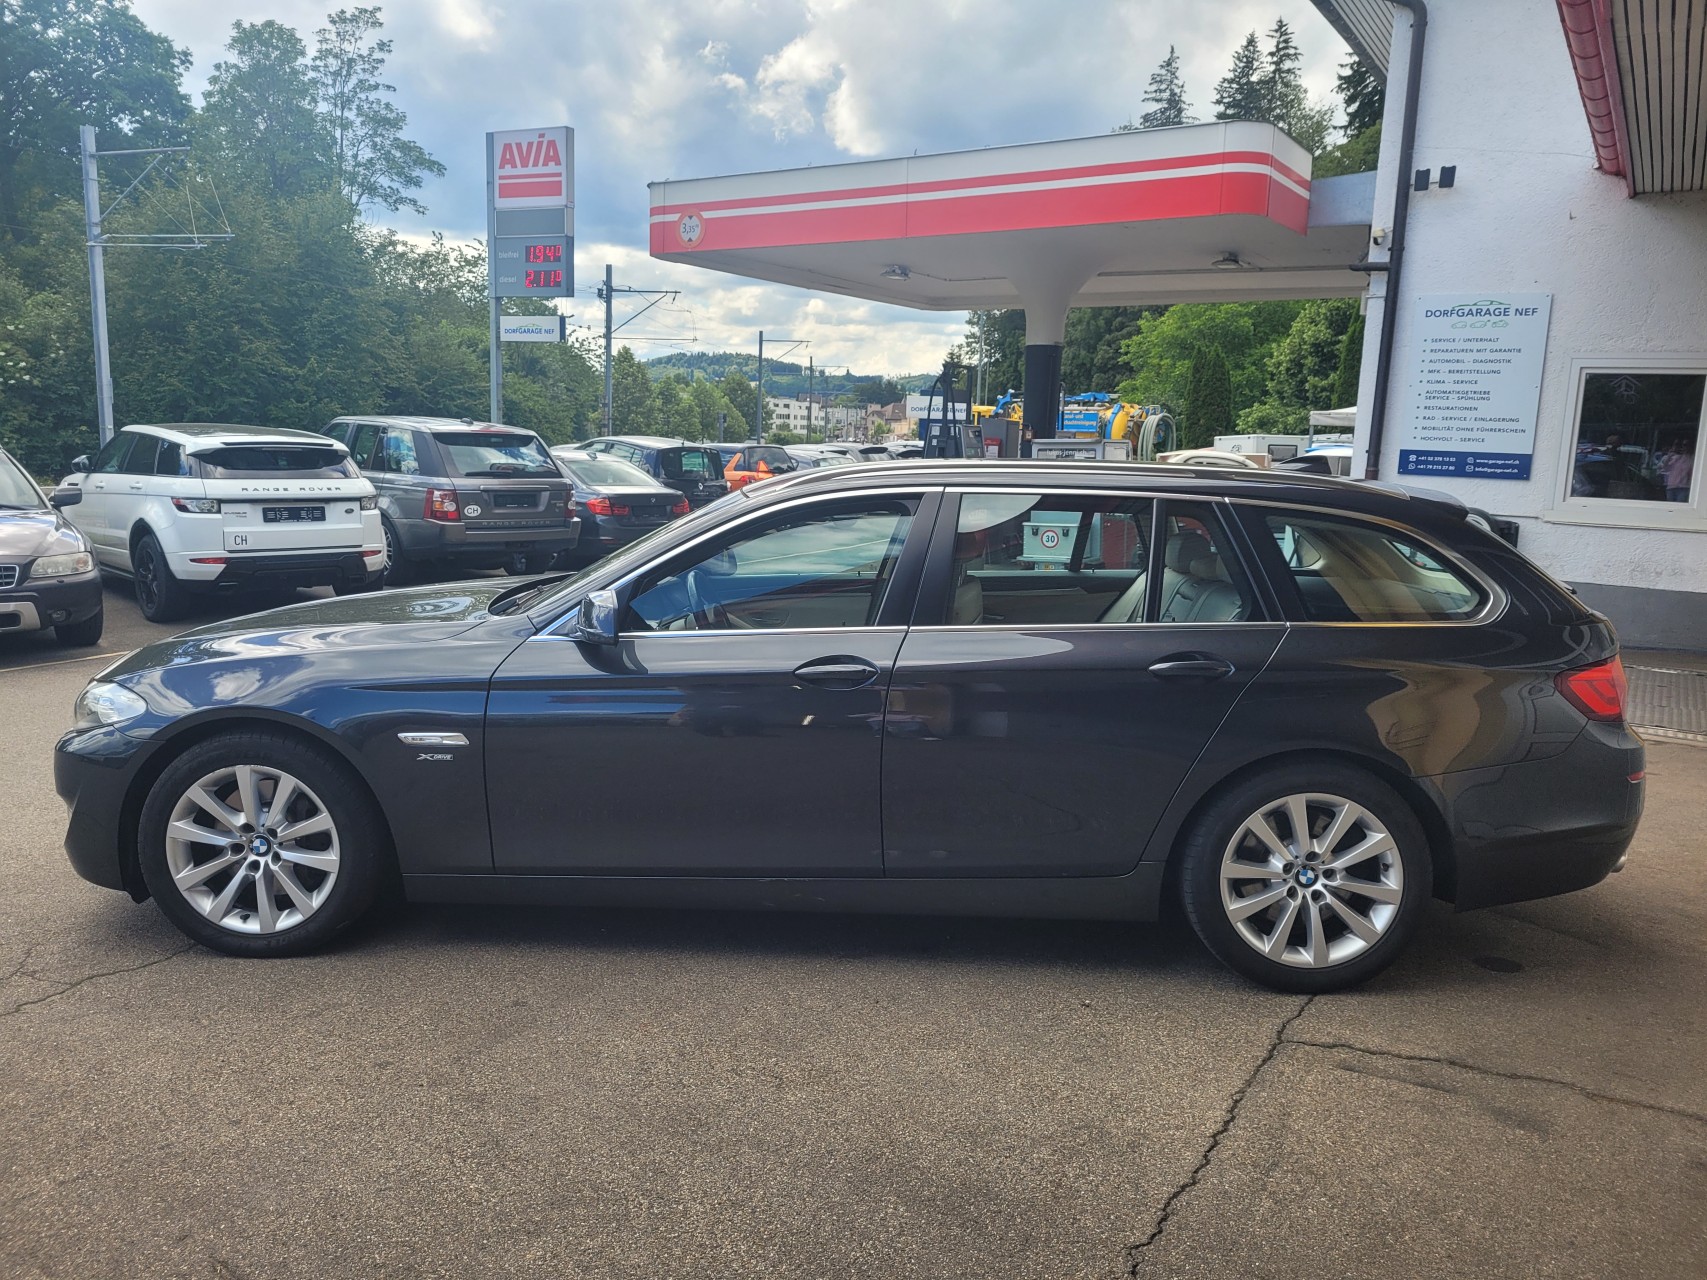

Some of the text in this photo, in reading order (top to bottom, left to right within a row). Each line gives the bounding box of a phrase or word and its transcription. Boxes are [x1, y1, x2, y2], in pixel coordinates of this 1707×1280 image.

[1425, 307, 1539, 318] DORFGARAGE NEF
[234, 534, 248, 546] CH
[1045, 535, 1055, 543] 30
